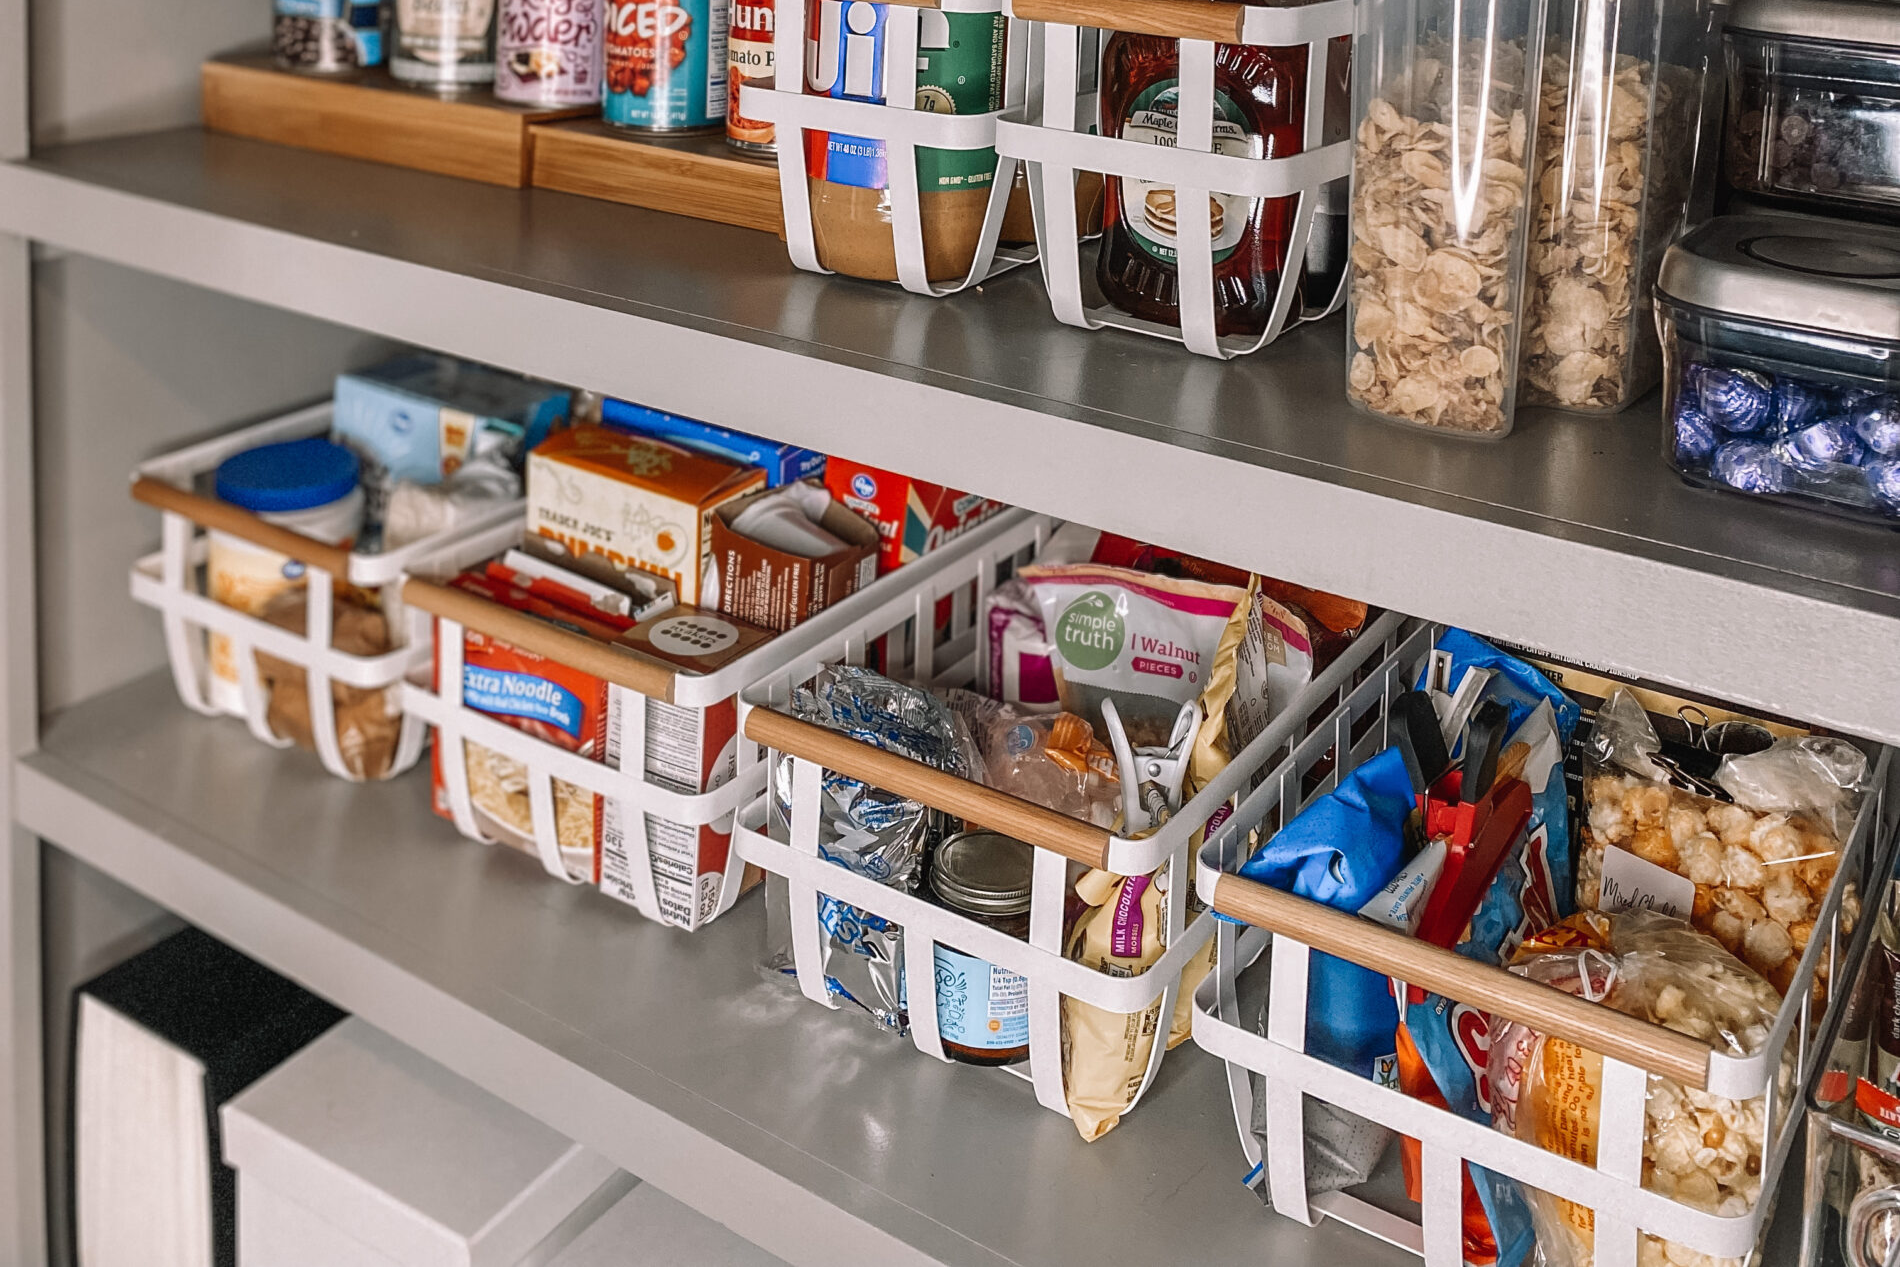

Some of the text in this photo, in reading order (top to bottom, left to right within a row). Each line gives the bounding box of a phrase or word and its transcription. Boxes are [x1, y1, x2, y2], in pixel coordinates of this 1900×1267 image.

[992, 15, 1000, 28] FAT
[991, 29, 999, 43] AND
[990, 44, 998, 83] SATURATED
[989, 84, 997, 95] FAT
[923, 94, 936, 112] 7g
[1142, 113, 1173, 130] Maple
[538, 507, 614, 543] TRADER JOE'S
[723, 550, 736, 612] DIRECTIONS
[792, 563, 800, 579] FREE
[790, 580, 799, 604] GLUTEN
[1068, 610, 1117, 632] simple
[1064, 625, 1115, 651] truth
[1141, 636, 1201, 666] Walnut
[1489, 637, 1640, 681] FOOTBALL PLAYOFF NATIONAL CHAMPIONSHIP
[1139, 660, 1178, 676] PIECES
[502, 674, 563, 707] Noodle
[605, 834, 623, 848] 130
[1602, 875, 1636, 911] Mixed
[662, 897, 692, 917] Datos
[1115, 928, 1127, 954] MILK
[1131, 922, 1140, 955] MORSELS
[1002, 976, 1012, 984] Tsp
[1891, 970, 1900, 1040] dark chocolate
[1566, 1054, 1576, 1081] heat
[1562, 1082, 1575, 1104] and
[1568, 1095, 1581, 1112] Do
[1581, 1127, 1591, 1138] is
